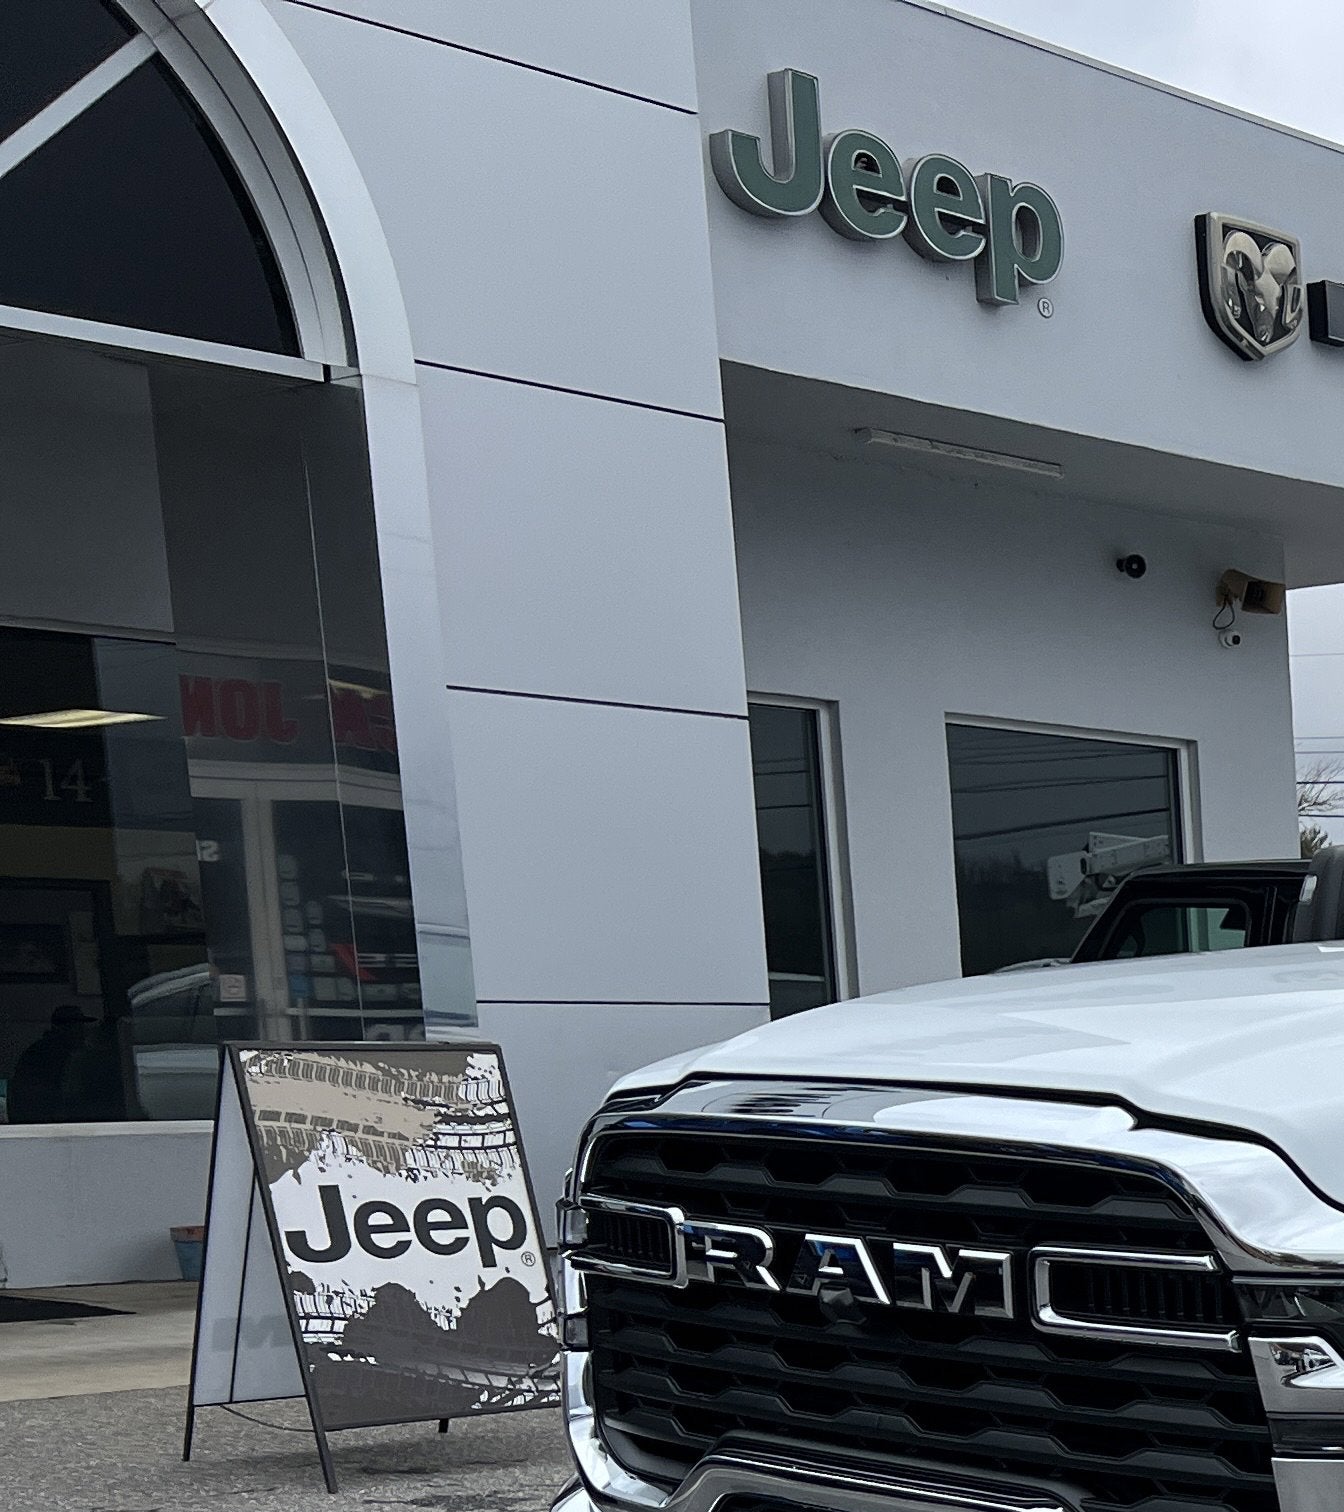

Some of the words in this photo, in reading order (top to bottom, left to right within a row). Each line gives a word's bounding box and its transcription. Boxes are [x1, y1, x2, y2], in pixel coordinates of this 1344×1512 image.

[710, 67, 1063, 305] Jeep
[285, 1185, 528, 1267] Jeep
[683, 1219, 1014, 1318] RAM
